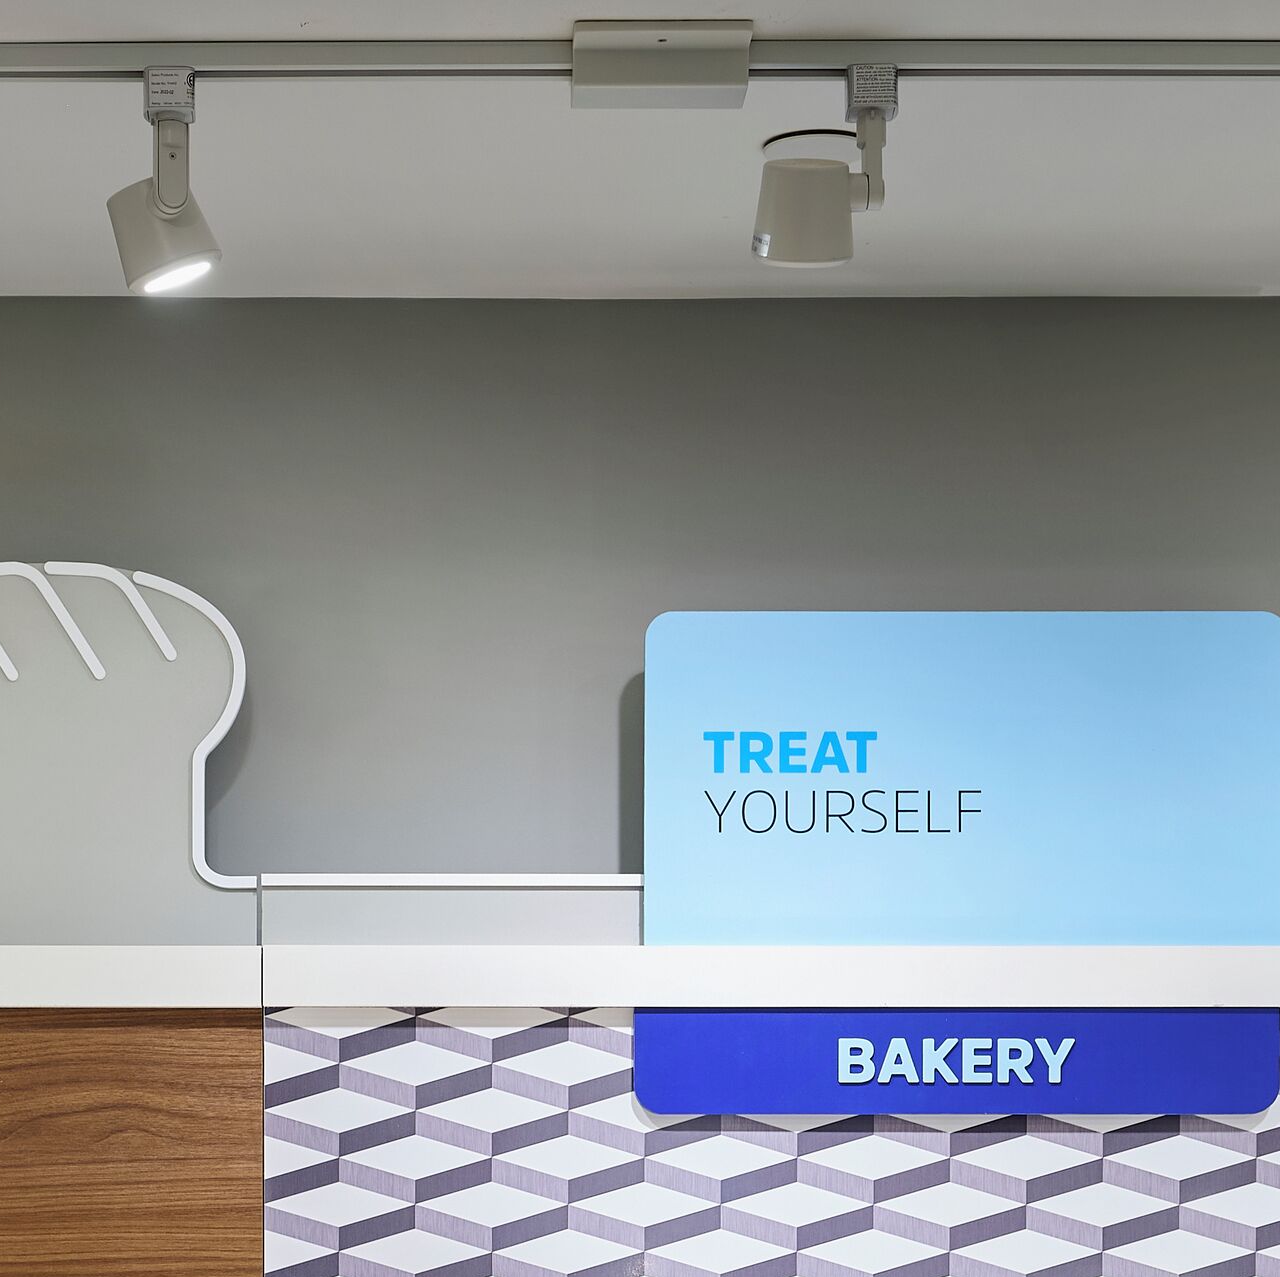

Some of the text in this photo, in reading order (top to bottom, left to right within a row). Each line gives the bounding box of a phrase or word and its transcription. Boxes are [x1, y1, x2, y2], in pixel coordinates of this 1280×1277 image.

[702, 730, 878, 774] TREAT
[703, 789, 982, 834] YOURSELF
[836, 1036, 1077, 1087] BAKERY
